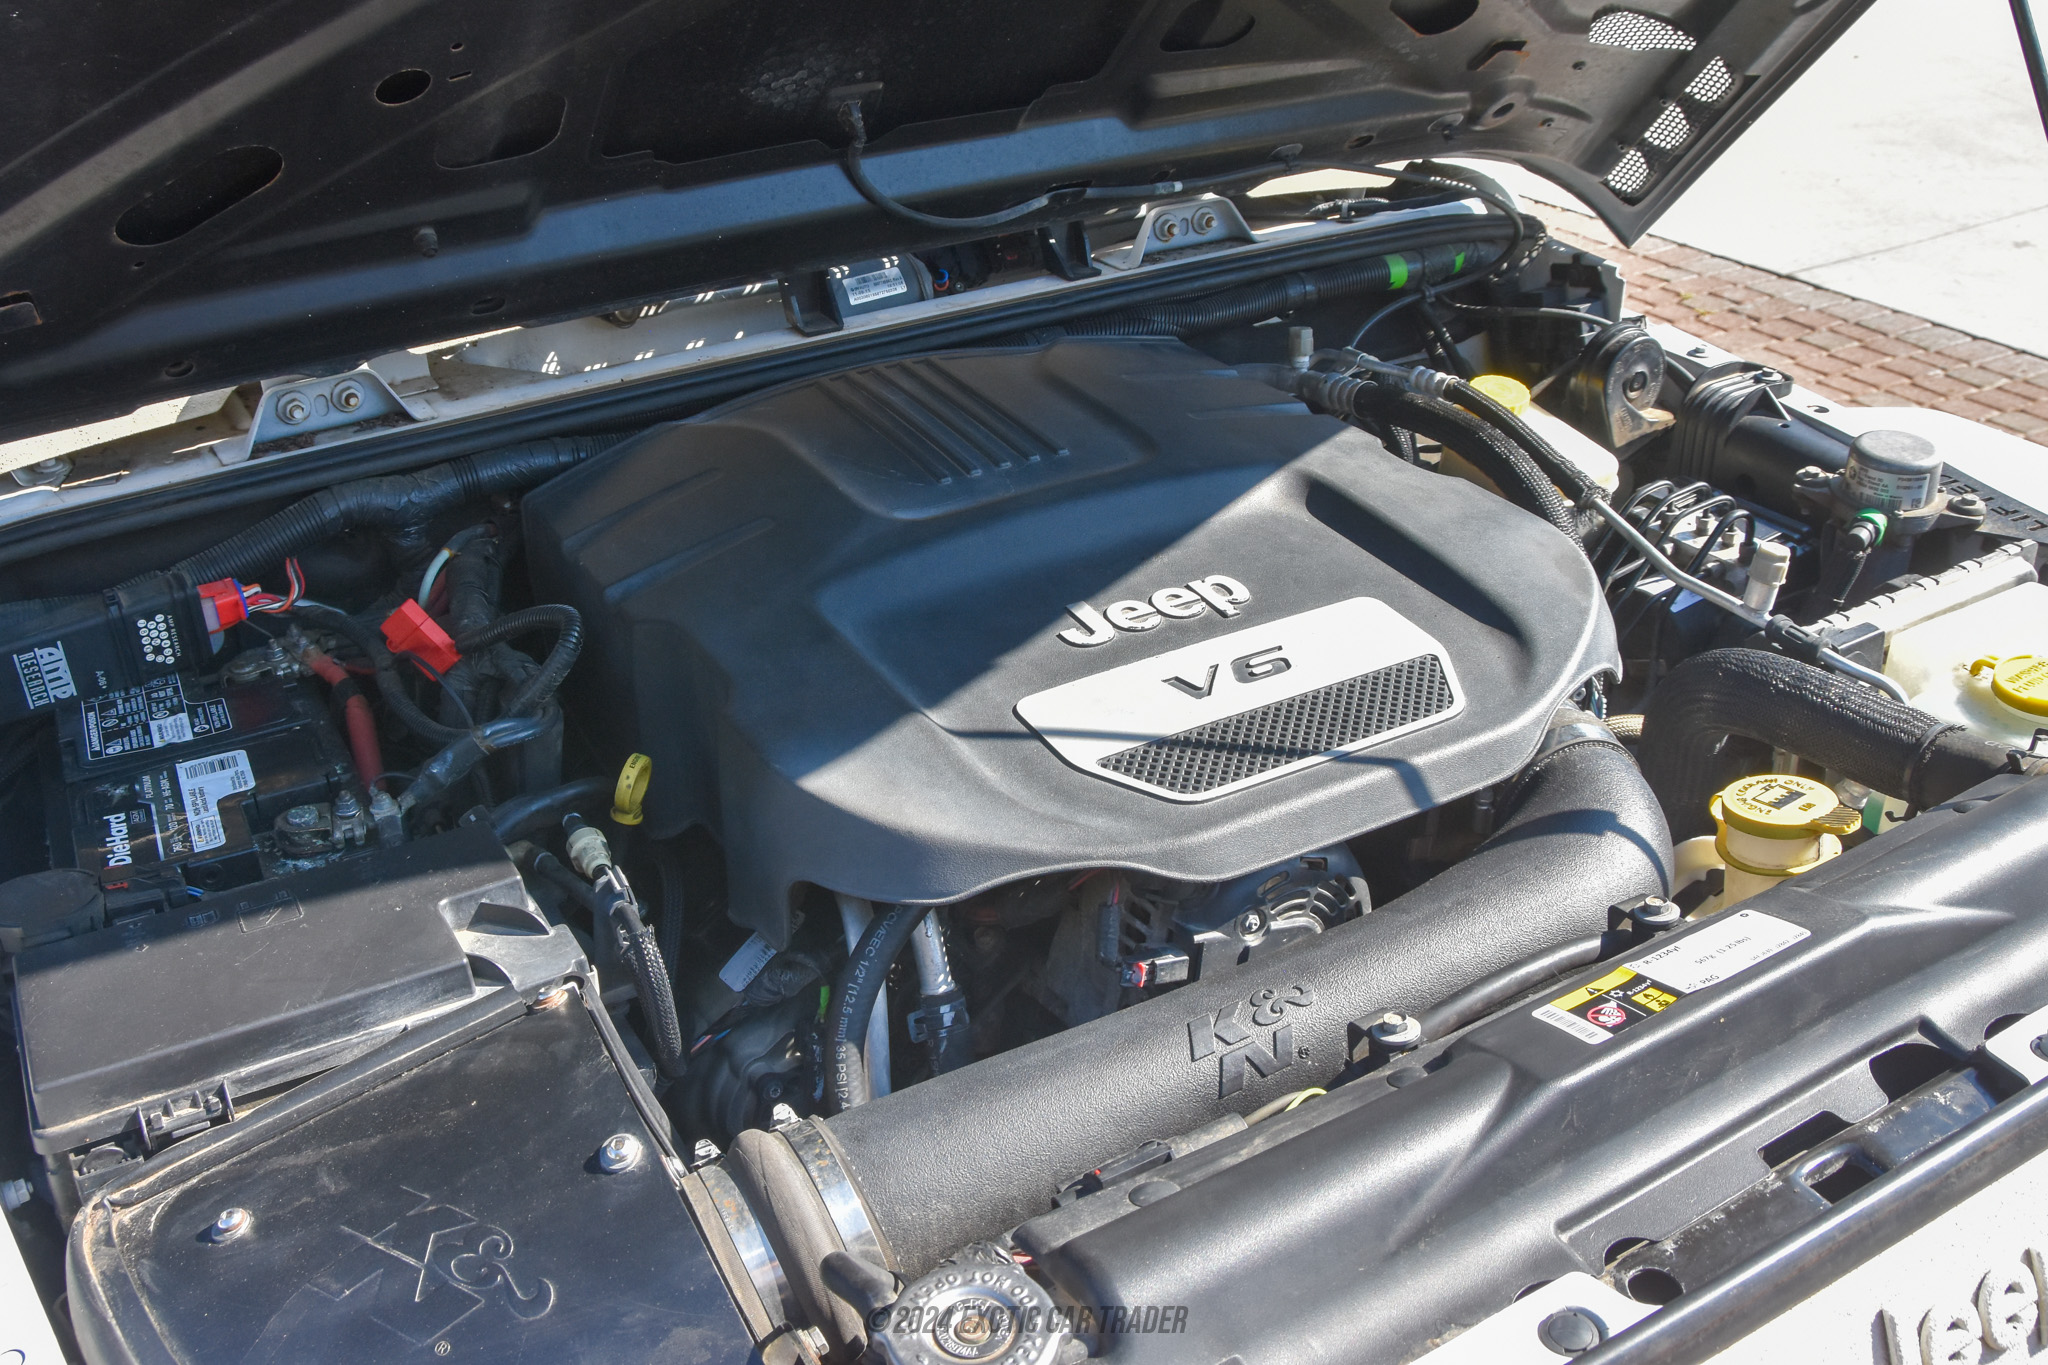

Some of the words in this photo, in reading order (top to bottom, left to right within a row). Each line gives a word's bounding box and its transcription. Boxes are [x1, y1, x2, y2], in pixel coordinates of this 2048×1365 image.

[1056, 574, 1250, 649] Jeep
[170, 628, 182, 657] RESEARCH
[18, 651, 50, 707] RESEARCH
[1161, 645, 1292, 699] V6
[142, 774, 154, 799] PLATINUM
[1784, 779, 1816, 792] ONLY
[103, 812, 133, 867] DieHard
[1699, 974, 1720, 986] PAG
[835, 1045, 847, 1059] 35
[835, 1063, 848, 1085] PSI
[968, 1270, 1010, 1290] NOT
[1009, 1284, 1038, 1307] DO
